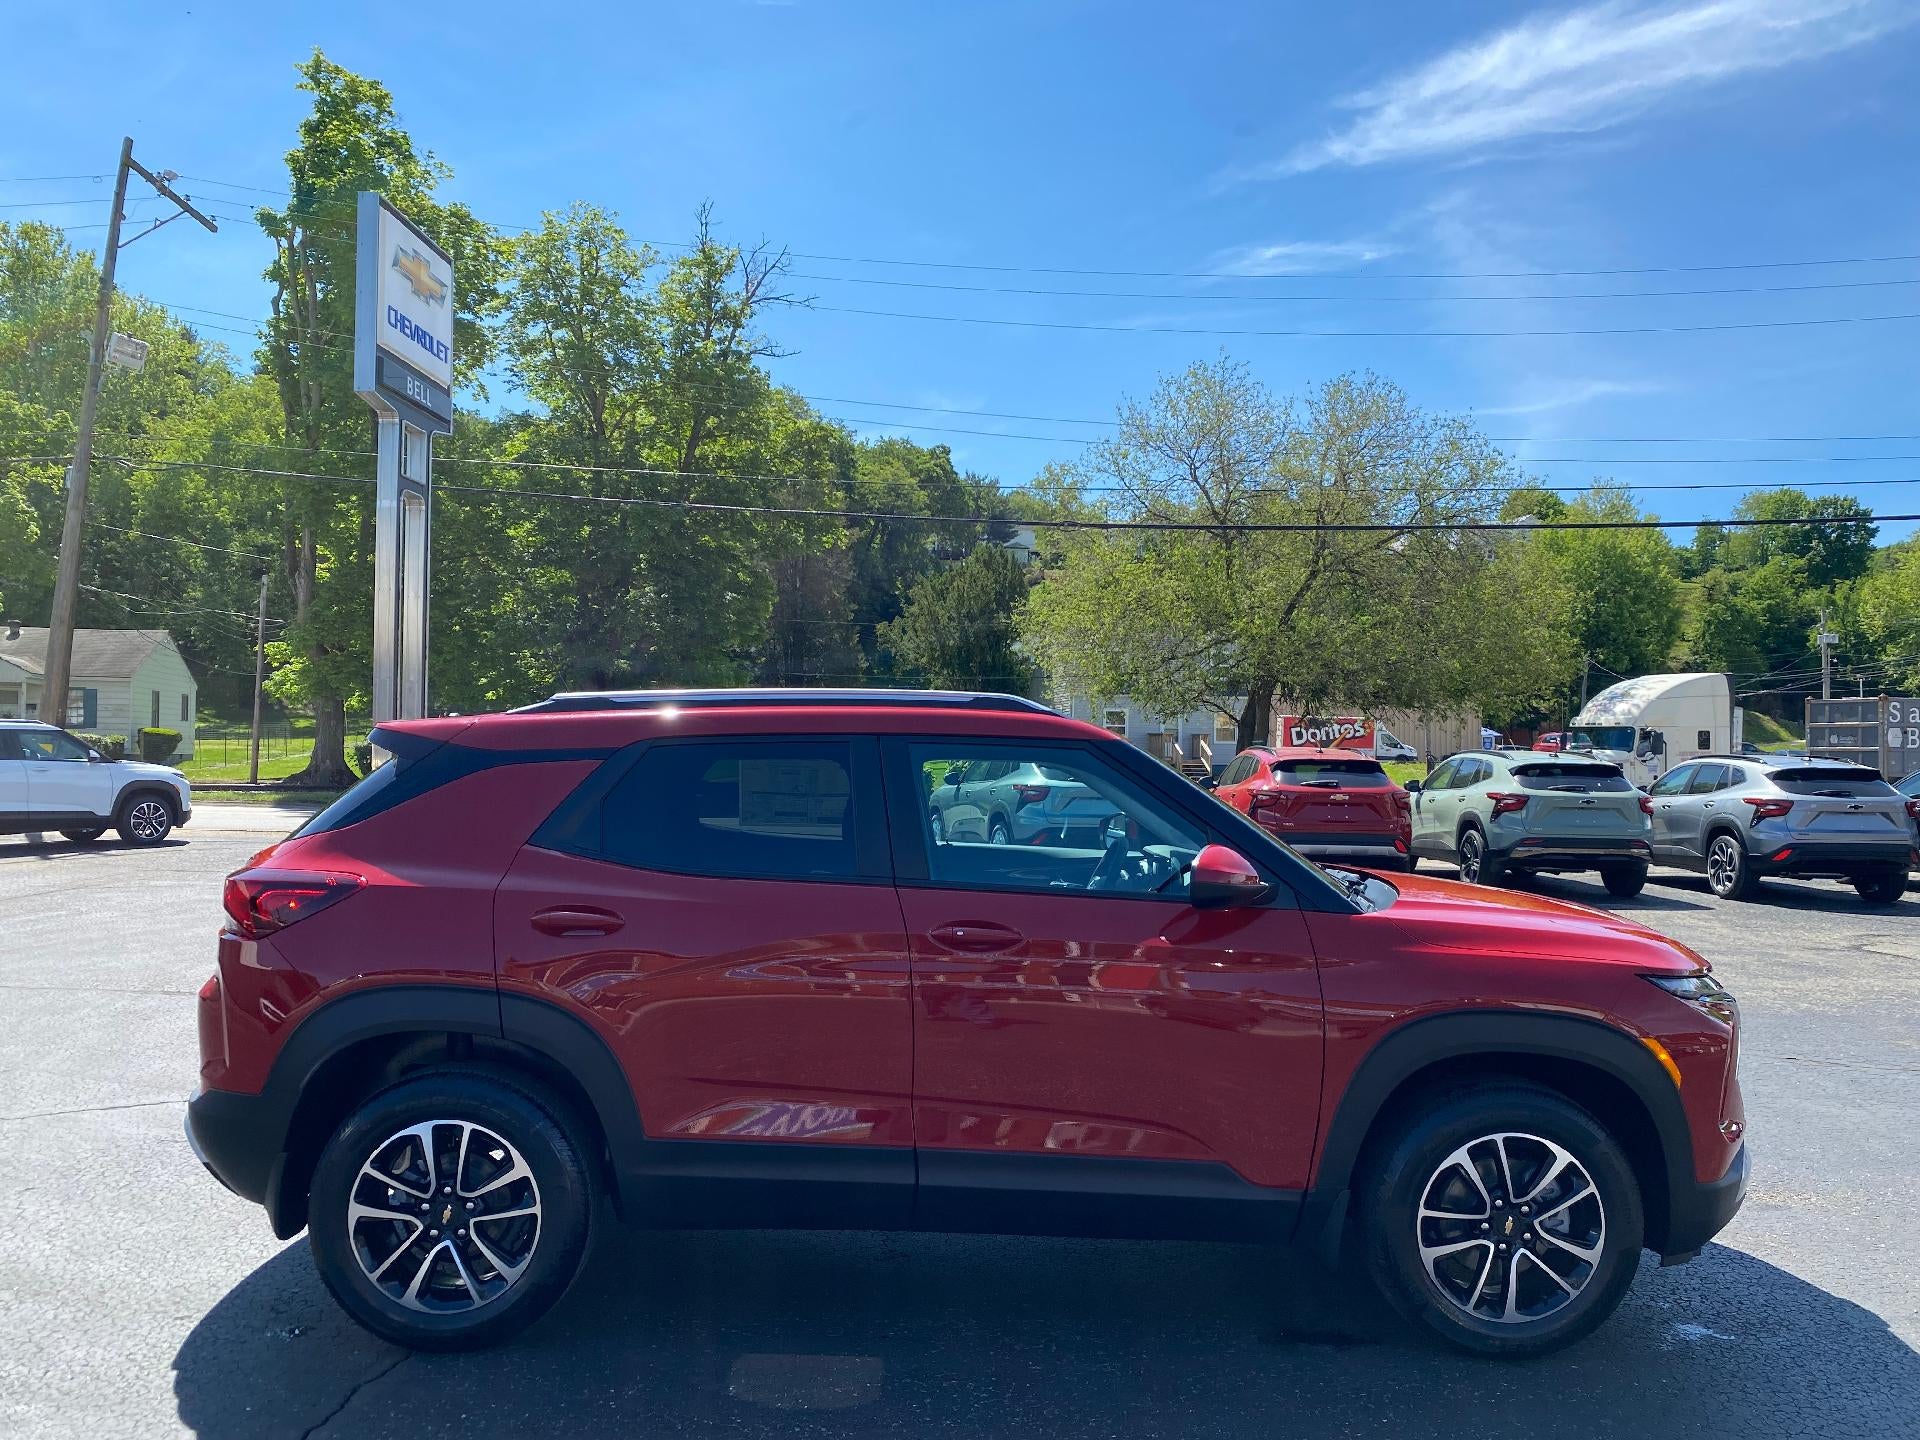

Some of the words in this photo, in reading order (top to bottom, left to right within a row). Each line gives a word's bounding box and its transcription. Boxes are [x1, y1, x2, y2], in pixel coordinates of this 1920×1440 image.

[387, 304, 449, 364] CHEVROLET
[407, 376, 432, 408] BELL
[1290, 720, 1365, 746] Doritos
